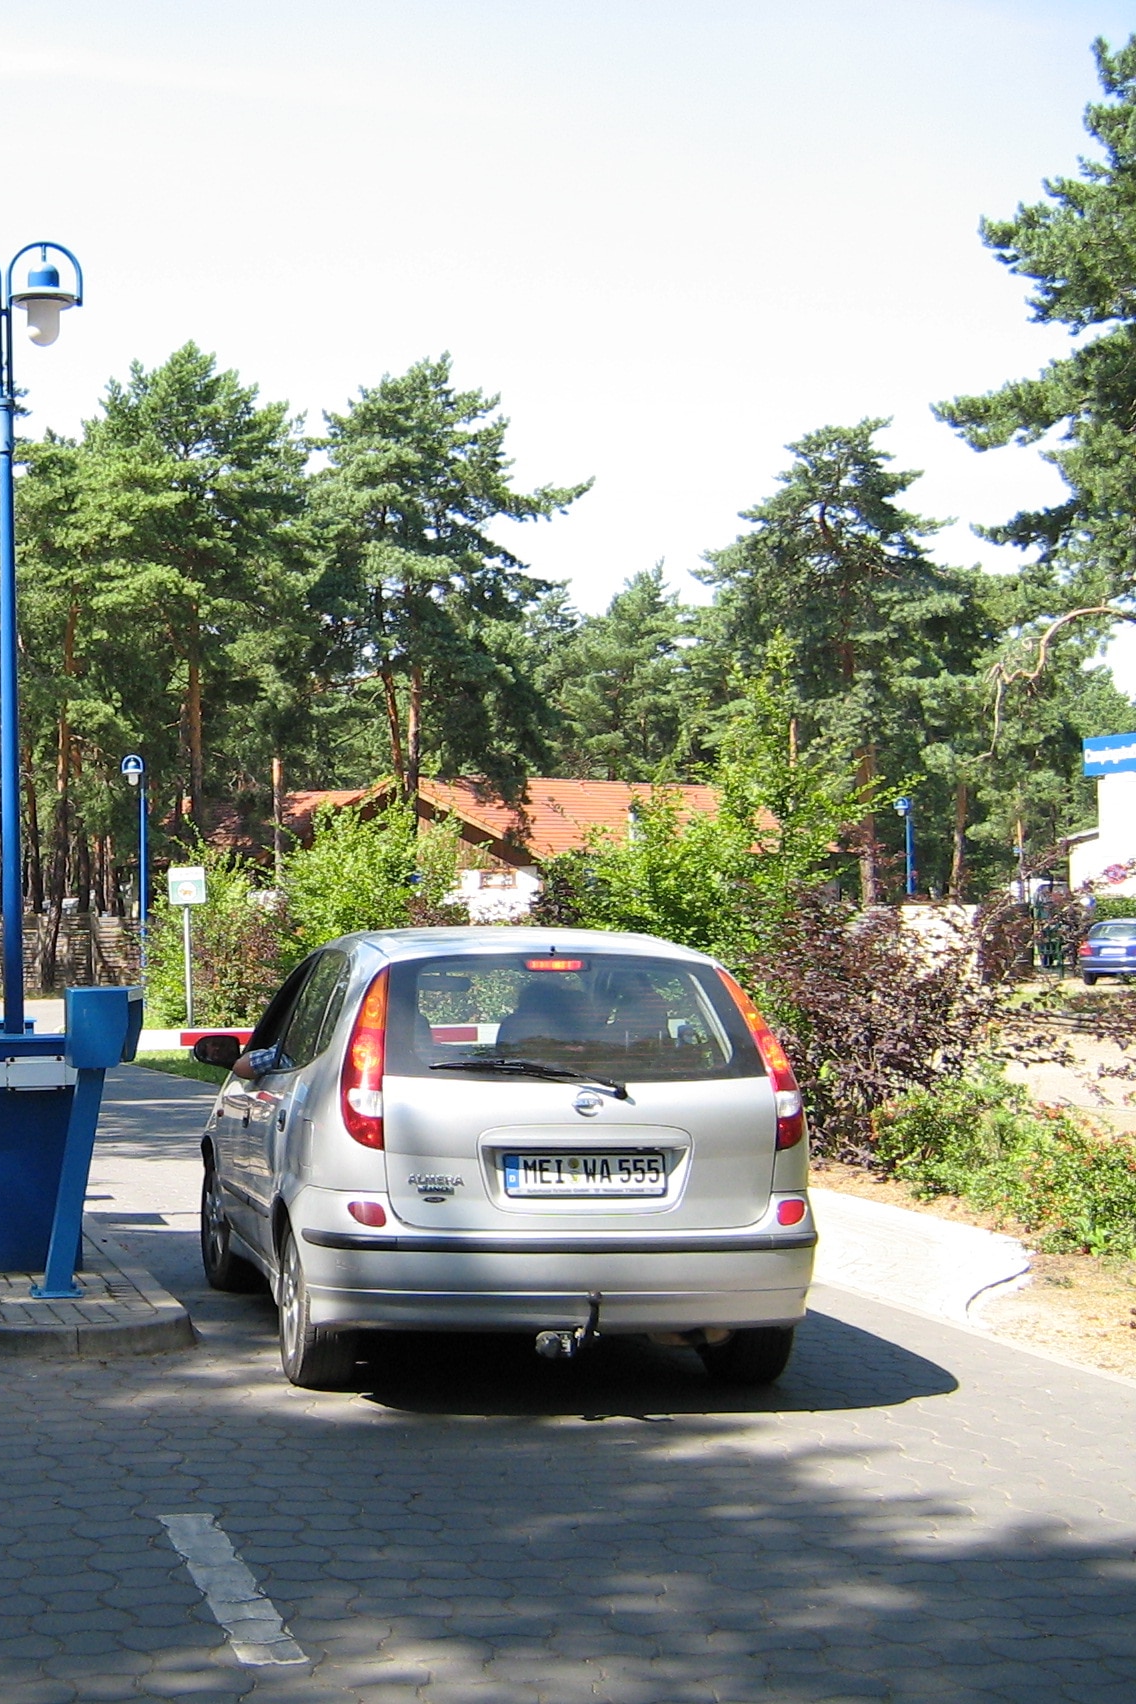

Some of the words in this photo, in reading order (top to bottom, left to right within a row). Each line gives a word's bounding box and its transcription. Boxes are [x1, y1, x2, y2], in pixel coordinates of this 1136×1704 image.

[408, 1173, 465, 1187] ALMERA
[523, 1159, 564, 1184] MEI
[583, 1159, 612, 1184] WA
[618, 1158, 660, 1184] 555
